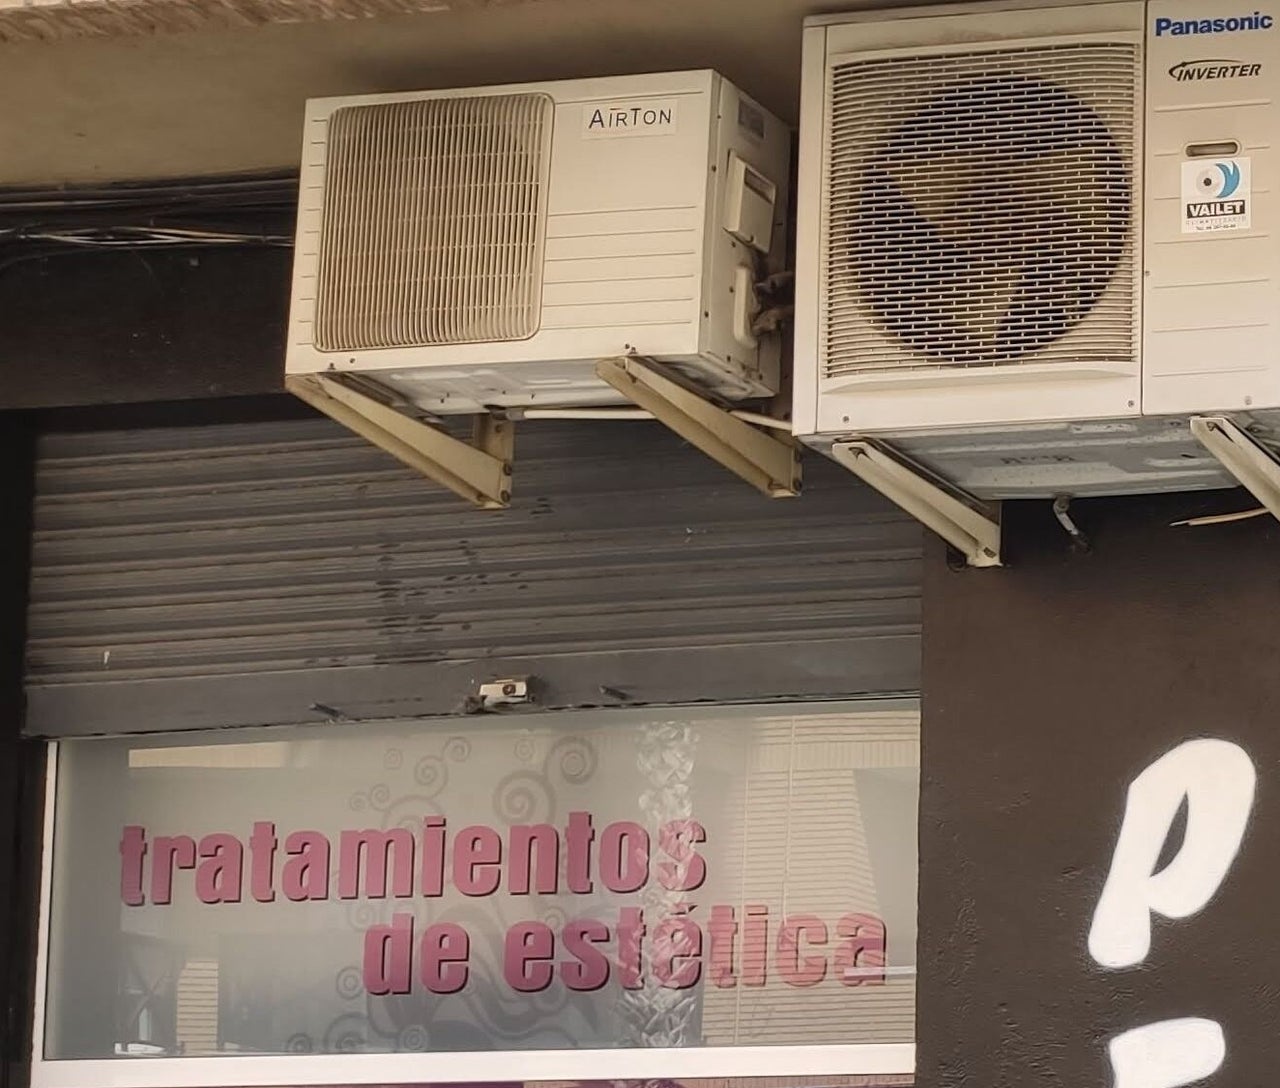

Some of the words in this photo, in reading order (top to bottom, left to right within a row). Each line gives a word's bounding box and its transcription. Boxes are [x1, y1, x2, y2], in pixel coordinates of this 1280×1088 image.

[1155, 12, 1273, 37] Panasonic
[1172, 61, 1262, 82] INVERTER
[1188, 201, 1243, 217] VAILET
[118, 811, 708, 906] tratamientos
[361, 911, 471, 997] de
[501, 903, 888, 993] estética
